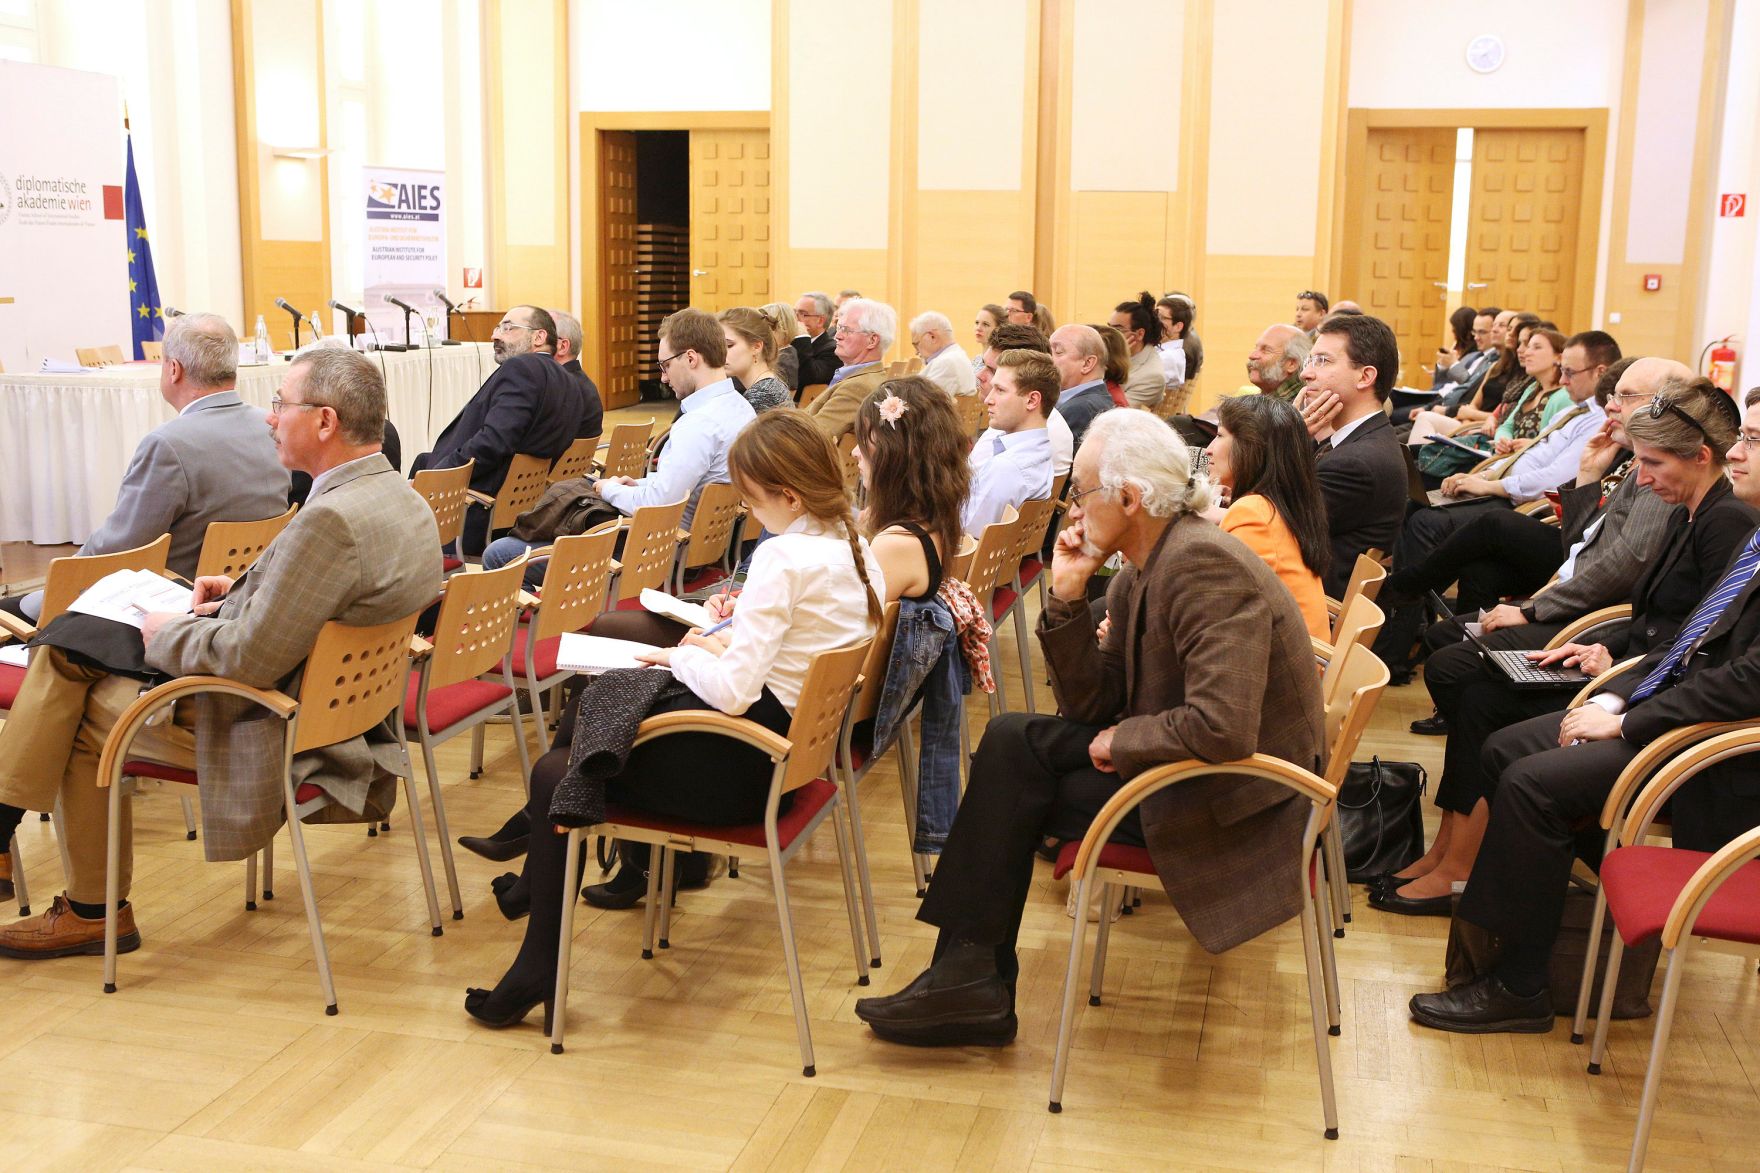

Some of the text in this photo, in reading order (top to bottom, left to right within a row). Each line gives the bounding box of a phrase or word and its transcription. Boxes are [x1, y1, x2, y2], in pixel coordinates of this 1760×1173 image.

[16, 174, 87, 195] diplomatische
[17, 193, 92, 210] akademie wien
[397, 183, 441, 211] AIES
